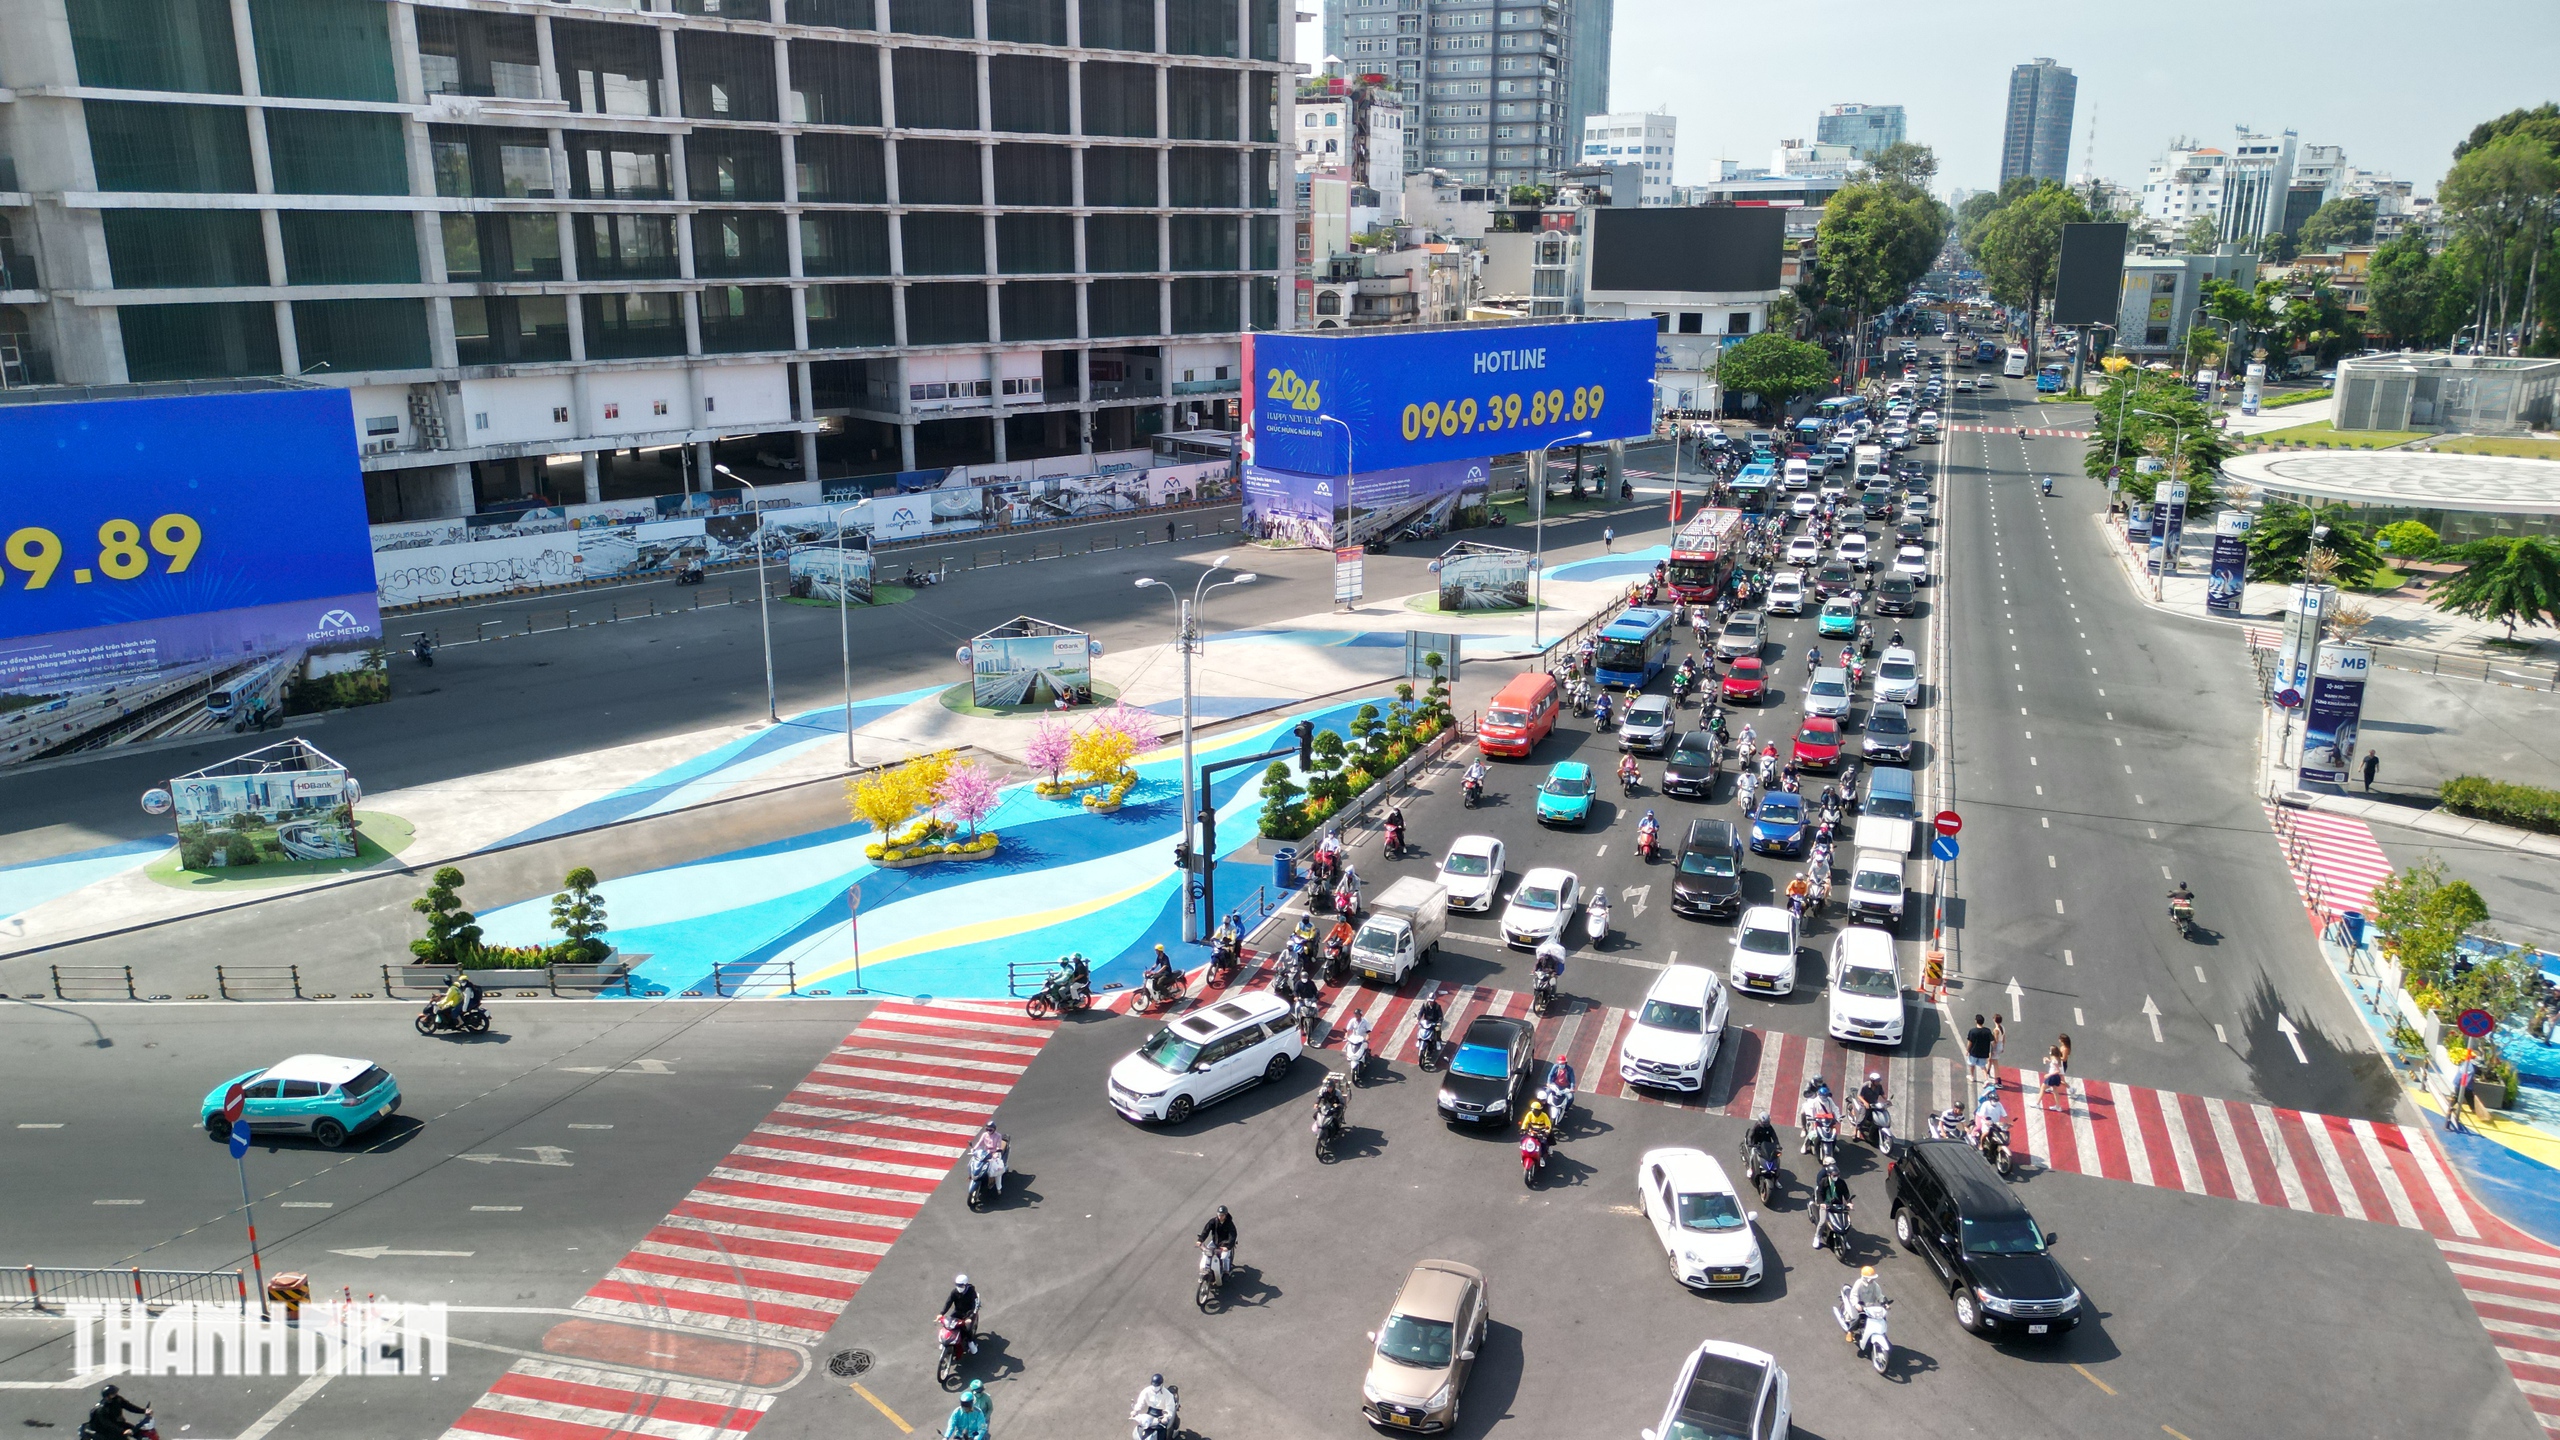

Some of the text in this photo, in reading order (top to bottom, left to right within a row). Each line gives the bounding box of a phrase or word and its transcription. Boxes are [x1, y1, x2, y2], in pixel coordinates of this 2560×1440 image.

[1473, 347, 1546, 374] HOTLINE
[1267, 368, 1321, 411] 2026
[1288, 414, 1303, 423] NEW
[1402, 385, 1605, 441] 0969.39.89.89
[2230, 521, 2250, 530] MB
[0, 513, 202, 590] 9.89
[307, 625, 370, 640] HCMC METRO
[68, 647, 90, 656] Thành
[59, 658, 77, 666] xanh
[2341, 657, 2367, 670] MB
[298, 781, 333, 790] HDBank
